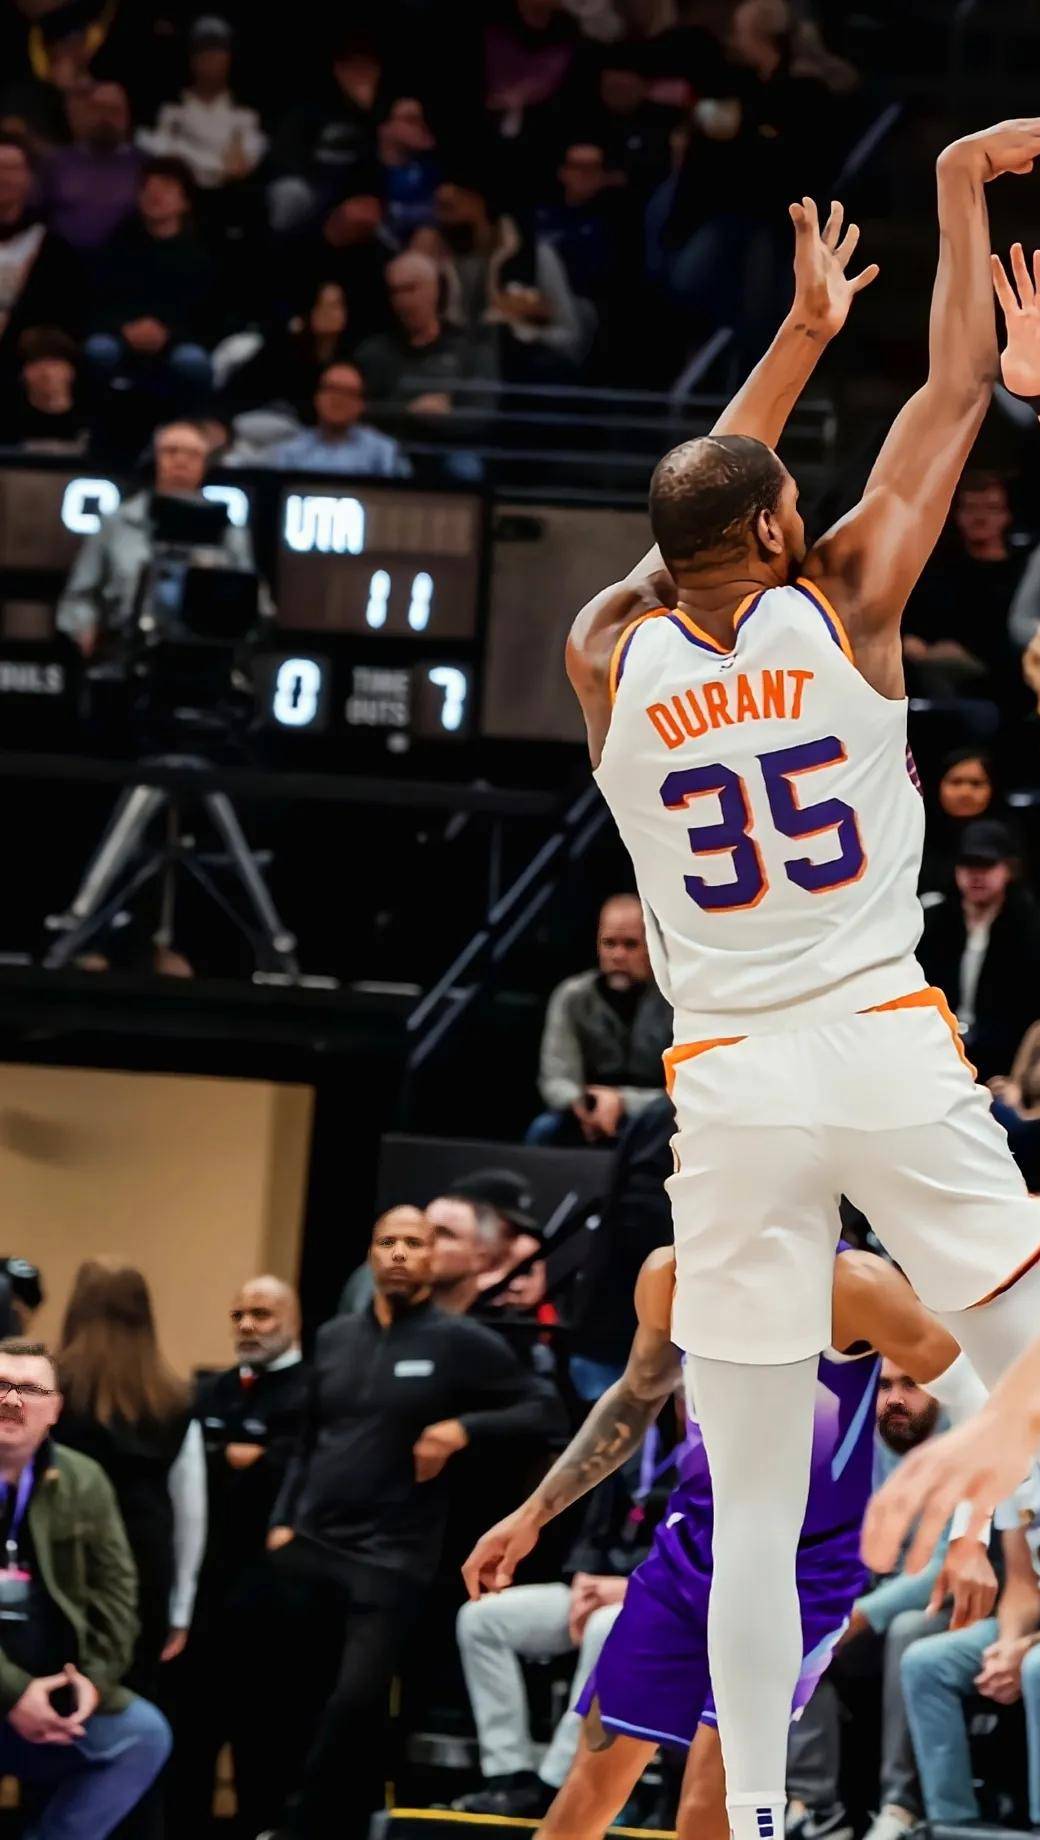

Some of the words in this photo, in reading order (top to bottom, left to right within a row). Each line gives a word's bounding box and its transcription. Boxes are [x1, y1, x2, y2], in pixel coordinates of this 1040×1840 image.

[285, 494, 365, 555] UTA
[366, 569, 434, 632] 11
[274, 657, 321, 726] 0
[428, 665, 467, 731] 7
[646, 669, 814, 750] DURANT
[659, 735, 868, 913] 35
